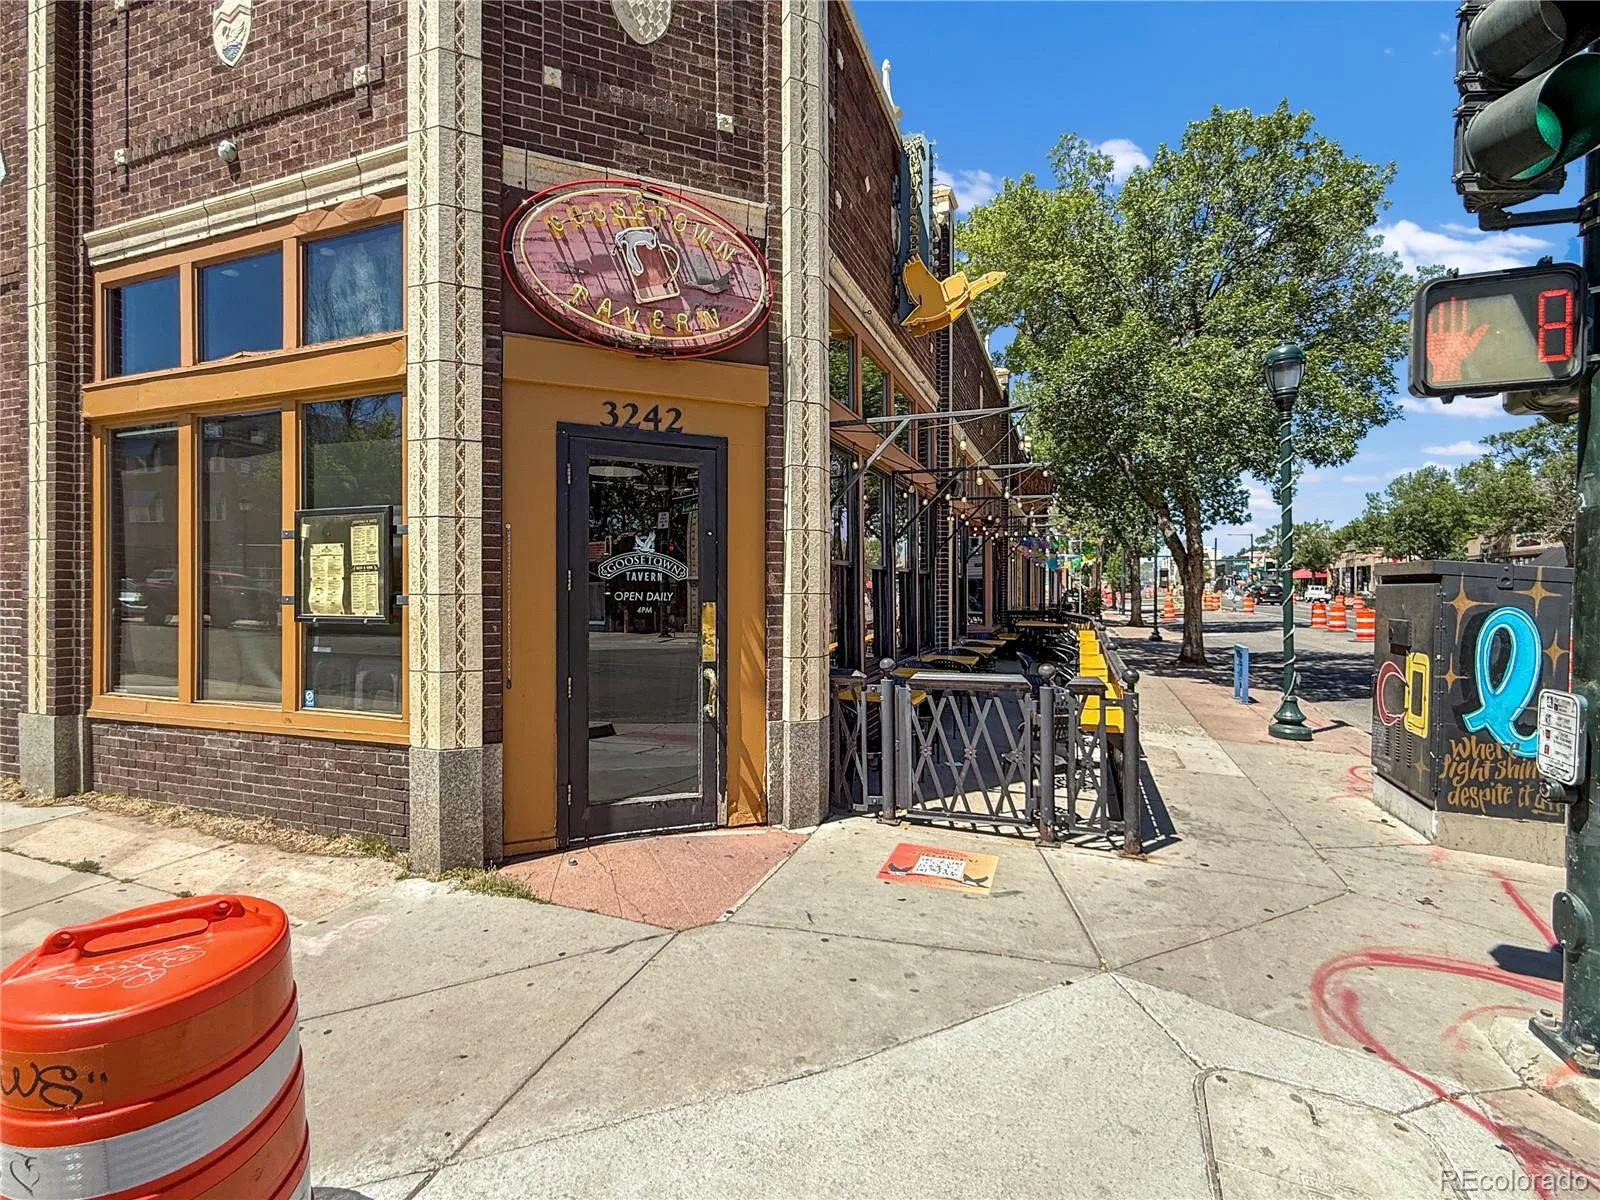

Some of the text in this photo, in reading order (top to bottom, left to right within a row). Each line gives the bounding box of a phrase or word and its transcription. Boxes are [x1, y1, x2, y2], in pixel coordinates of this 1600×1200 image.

[544, 199, 736, 262] GOOSETOWN
[570, 283, 721, 335] TAVERN
[1537, 288, 1575, 363] 8
[600, 401, 684, 433] 3242
[607, 555, 681, 575] GOOSETOWN
[625, 571, 663, 582] TAVERN
[614, 591, 674, 602] OPEN DAILY
[636, 606, 653, 614] 4PM
[1449, 735, 1520, 760] Where
[1447, 781, 1513, 814] despite
[1518, 781, 1535, 807] it
